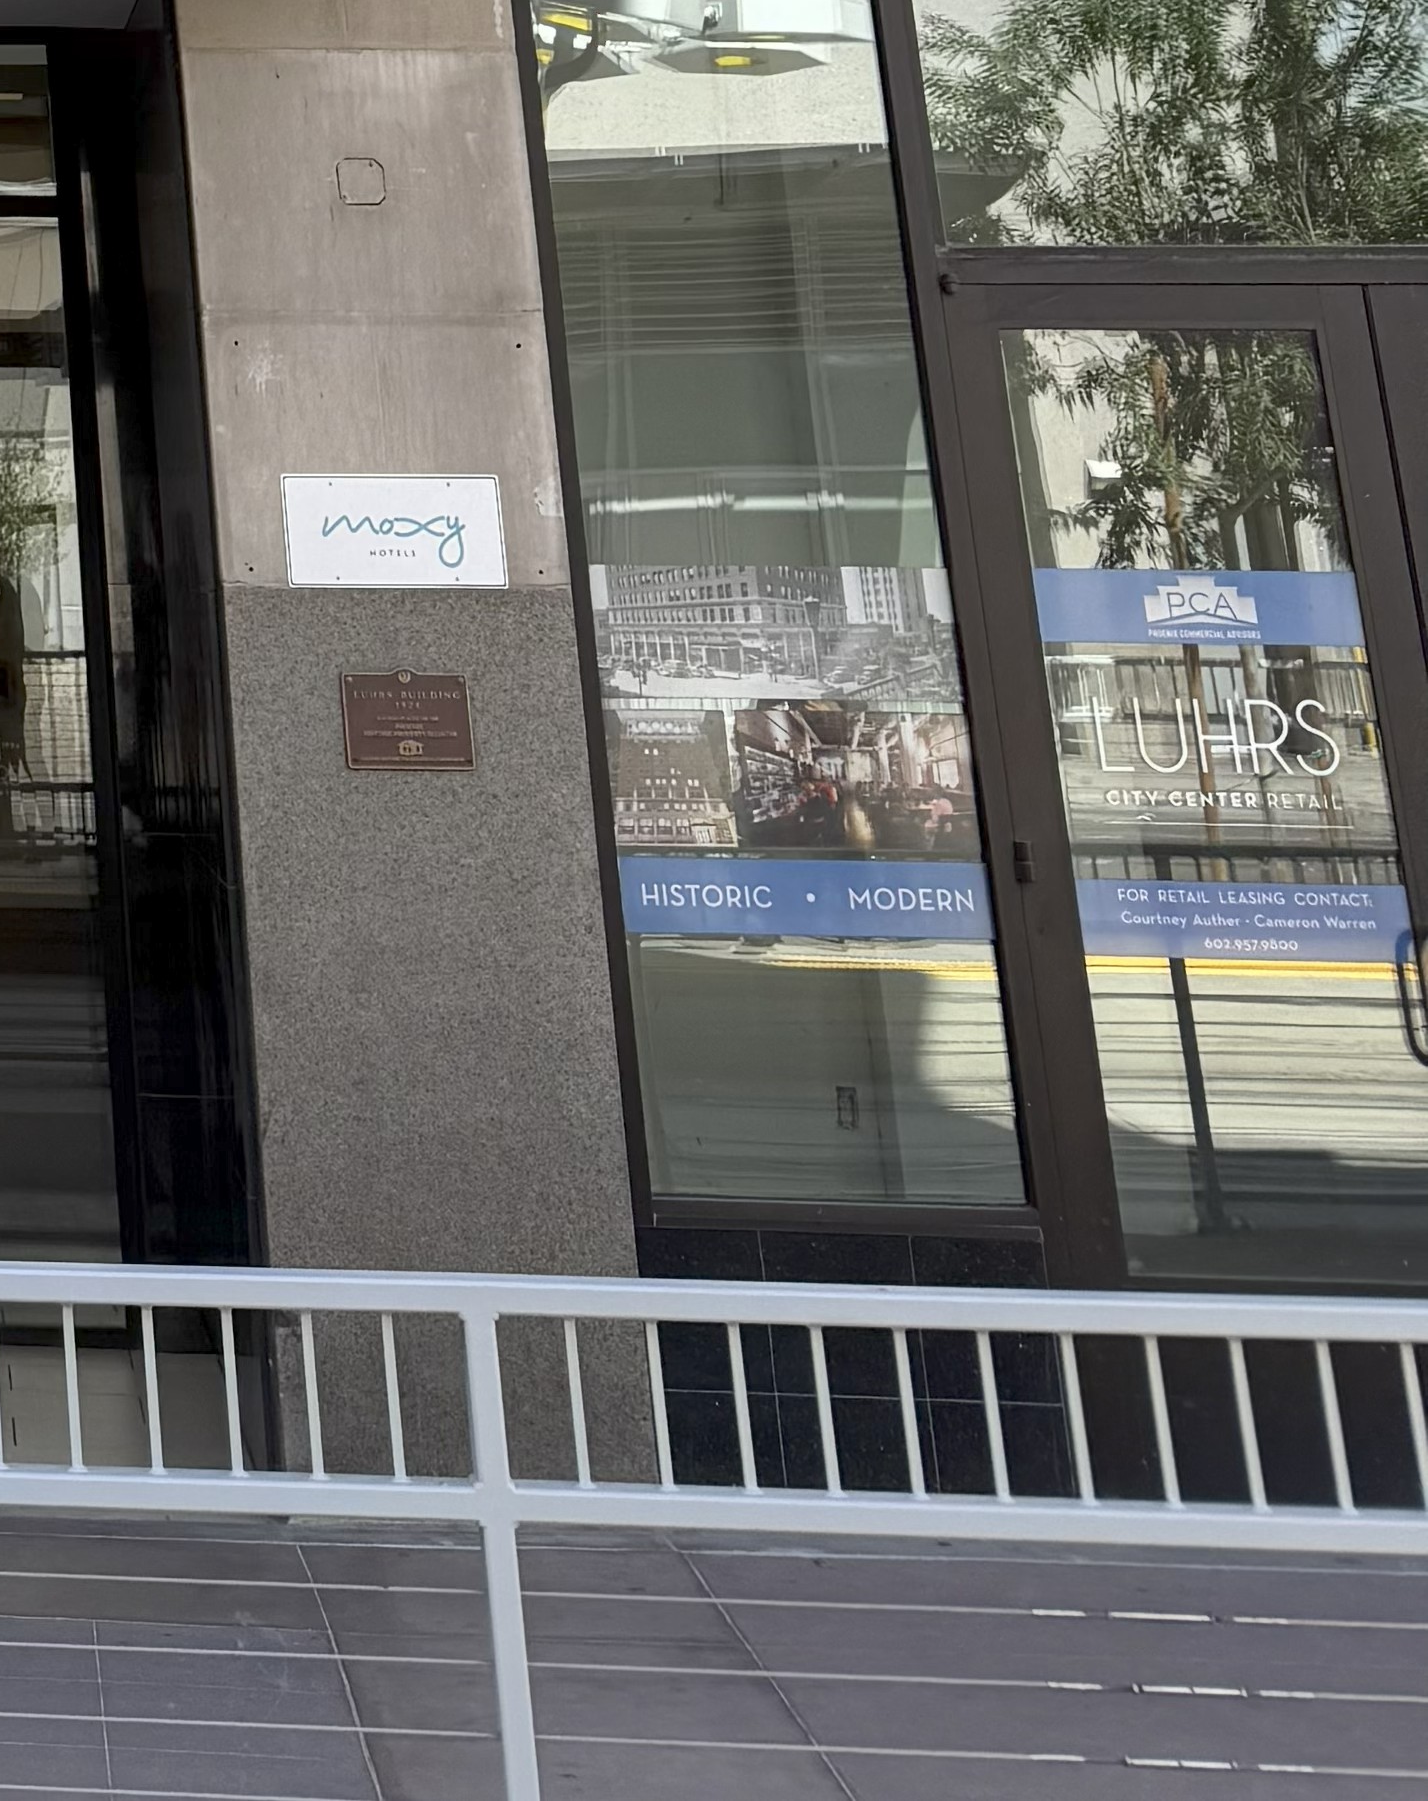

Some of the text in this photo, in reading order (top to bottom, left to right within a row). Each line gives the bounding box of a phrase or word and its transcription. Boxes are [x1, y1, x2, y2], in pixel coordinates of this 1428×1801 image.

[322, 514, 466, 568] moxy
[1166, 592, 1238, 620] PCA
[1092, 697, 1341, 777] LUHRS
[1105, 789, 1344, 812] CITY CENTER RETAIL
[641, 883, 976, 912] HISTORIC MODERN
[1117, 887, 1375, 908] FOR RETAIL LEASING CONTACT:
[1121, 910, 1187, 929] Courtney
[1254, 914, 1320, 930] Cameron
[1324, 915, 1377, 931] Warren
[1204, 936, 1299, 952] 602.957.9800
